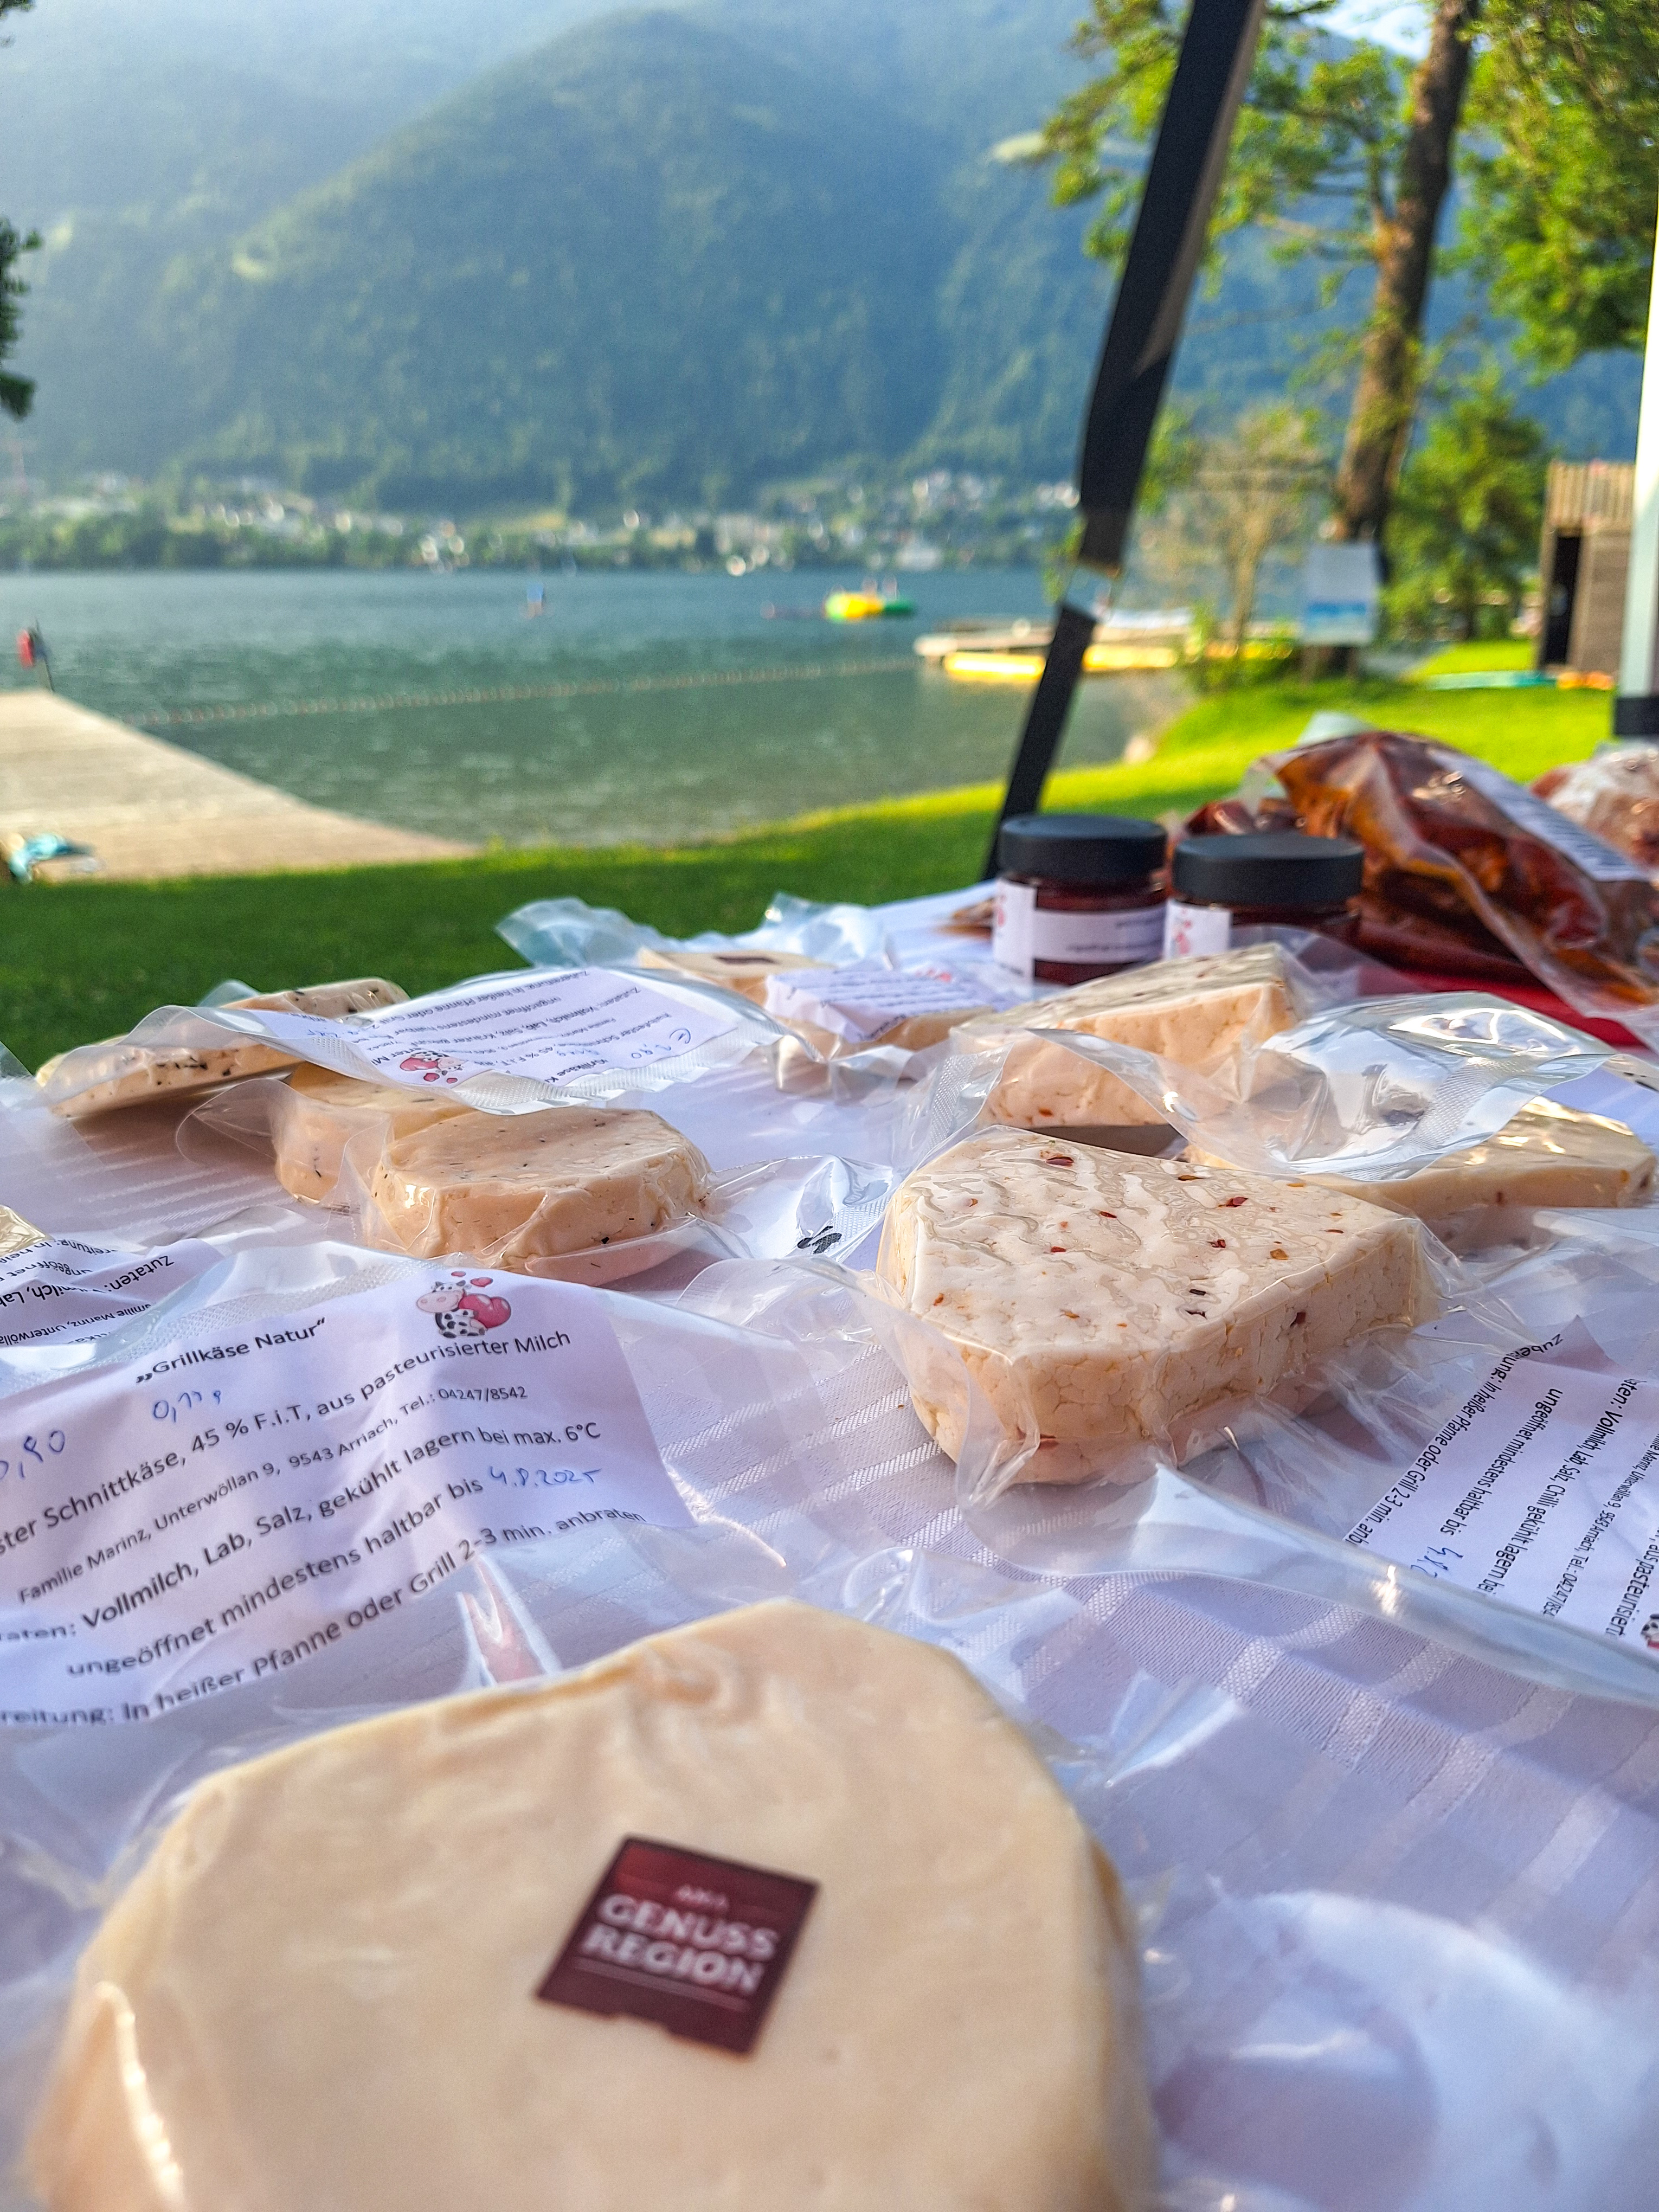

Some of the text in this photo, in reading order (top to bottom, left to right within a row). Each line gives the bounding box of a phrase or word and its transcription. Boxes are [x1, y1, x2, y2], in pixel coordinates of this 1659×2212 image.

[104, 1255, 175, 1293] Zutaten:
[136, 1316, 326, 1384] „Grillkäse Natur“
[1461, 1388, 1495, 1419] heißer
[1483, 1381, 1502, 1393] In
[43, 1452, 187, 1529] Schnittkäse,
[192, 1428, 220, 1452] 45
[226, 1418, 249, 1438] %
[317, 1393, 356, 1416] aus
[361, 1340, 510, 1400] pasteurisierter
[514, 1330, 571, 1354] Milch
[1435, 1414, 1471, 1446] Pfanne
[1576, 1410, 1623, 1450] Vollmilch,
[1415, 1444, 1442, 1472] oder
[1439, 1388, 1564, 1535] ungeöffnet mindestens haltbar bis
[1548, 1464, 1581, 1482] Salz,
[1564, 1450, 1594, 1465] Lab,
[20, 1386, 528, 1605] Familie Marinz, Unterwöllan 9, 9543 Arriach, Tel.: 04247/8542
[1384, 1487, 1411, 1507] 2-3
[1397, 1470, 1426, 1493] Grill
[1536, 1484, 1566, 1508] Chilli
[82, 1562, 199, 1630] Vollmilch,
[203, 1533, 253, 1565] Lab,
[256, 1505, 312, 1535] Salz,
[319, 1459, 402, 1518] gekühlt
[404, 1429, 475, 1465] lagern
[477, 1426, 510, 1444] bei
[513, 1430, 562, 1445] max.
[565, 1422, 601, 1442] 6°C
[1365, 1502, 1393, 1524] min.
[1510, 1505, 1546, 1545] gekühlt
[67, 1478, 484, 1675] ungeöffnet mindestens haltbar bis
[1487, 1542, 1529, 1580] lagern
[123, 1702, 150, 1721] In
[156, 1668, 245, 1710] heißer
[253, 1622, 342, 1677] Pfanne
[347, 1588, 402, 1628] oder
[410, 1551, 456, 1593] Grill
[458, 1527, 497, 1561] 2-3
[502, 1524, 552, 1542] min.
[555, 1507, 647, 1531] anbraten
[600, 1892, 779, 1961] GENUSS
[581, 1922, 768, 1995] REGION
